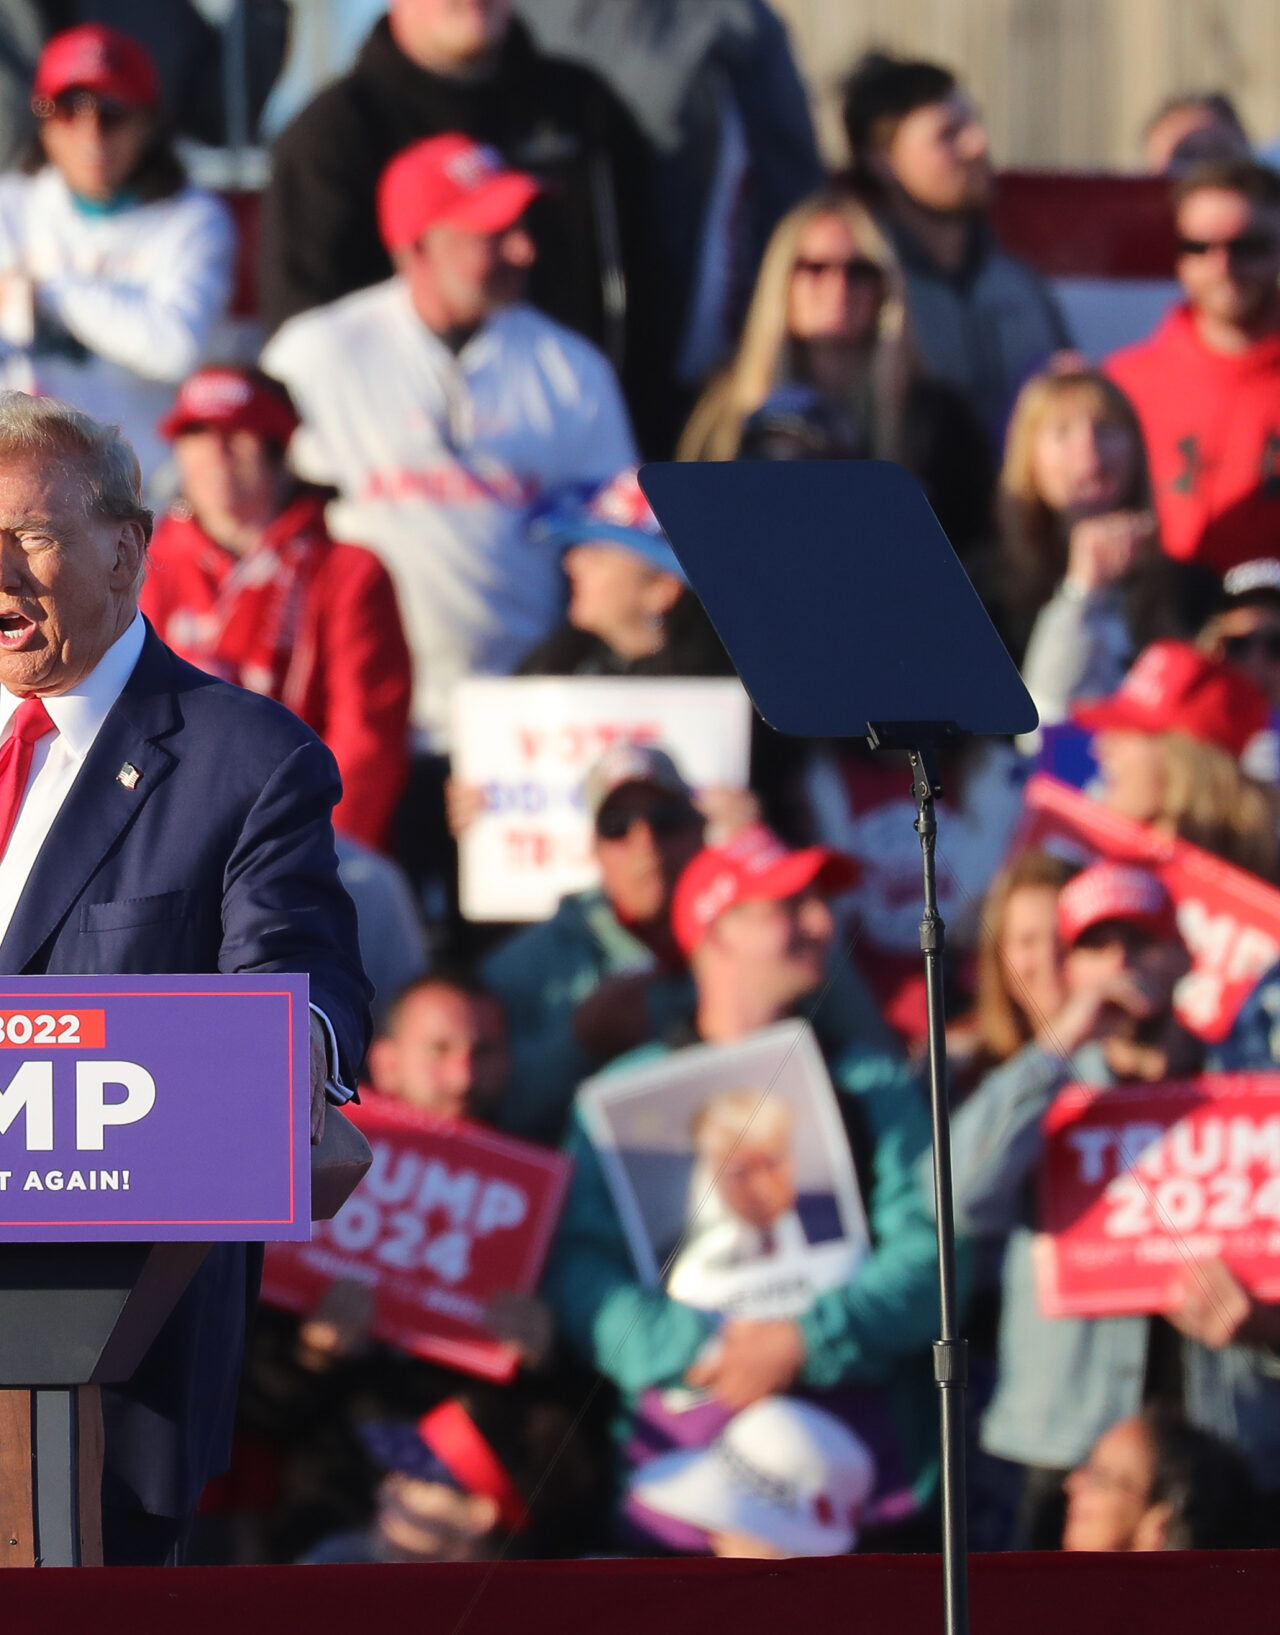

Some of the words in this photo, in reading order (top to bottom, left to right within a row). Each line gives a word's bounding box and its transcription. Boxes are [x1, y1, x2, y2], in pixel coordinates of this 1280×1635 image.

[23, 1170, 130, 1191] AGAIN!
[1069, 1114, 1280, 1184] TRUM
[365, 1139, 528, 1239] UMP
[328, 1198, 470, 1281] 024
